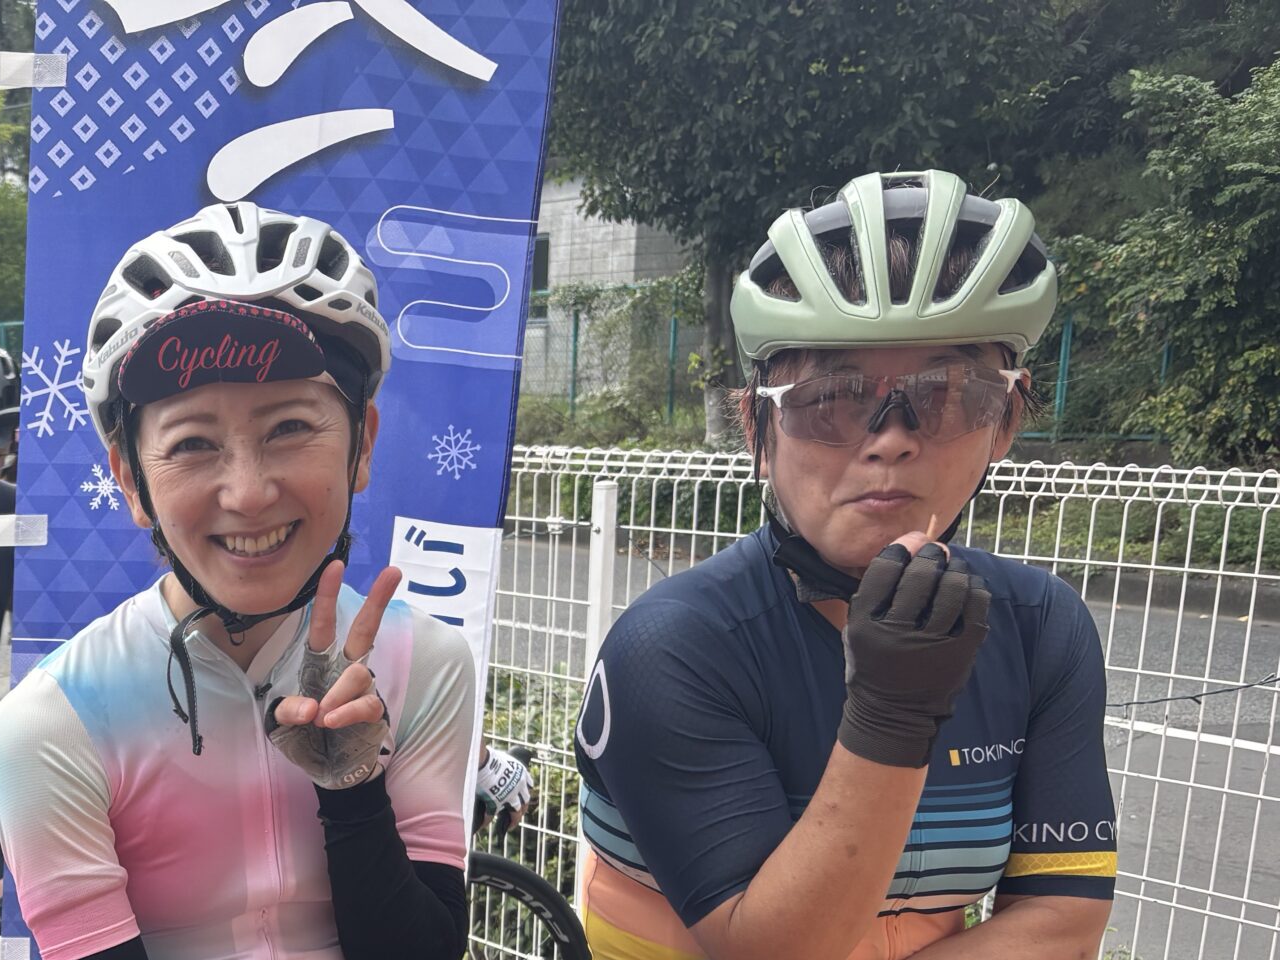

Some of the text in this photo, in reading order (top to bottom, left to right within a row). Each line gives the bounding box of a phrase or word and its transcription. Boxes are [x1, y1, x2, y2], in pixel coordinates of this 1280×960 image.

[98, 327, 138, 369] Kabuto
[157, 333, 282, 389] Cycling
[343, 764, 370, 785] gel
[488, 759, 517, 795] BORA
[1013, 820, 1117, 843] KINO CY
